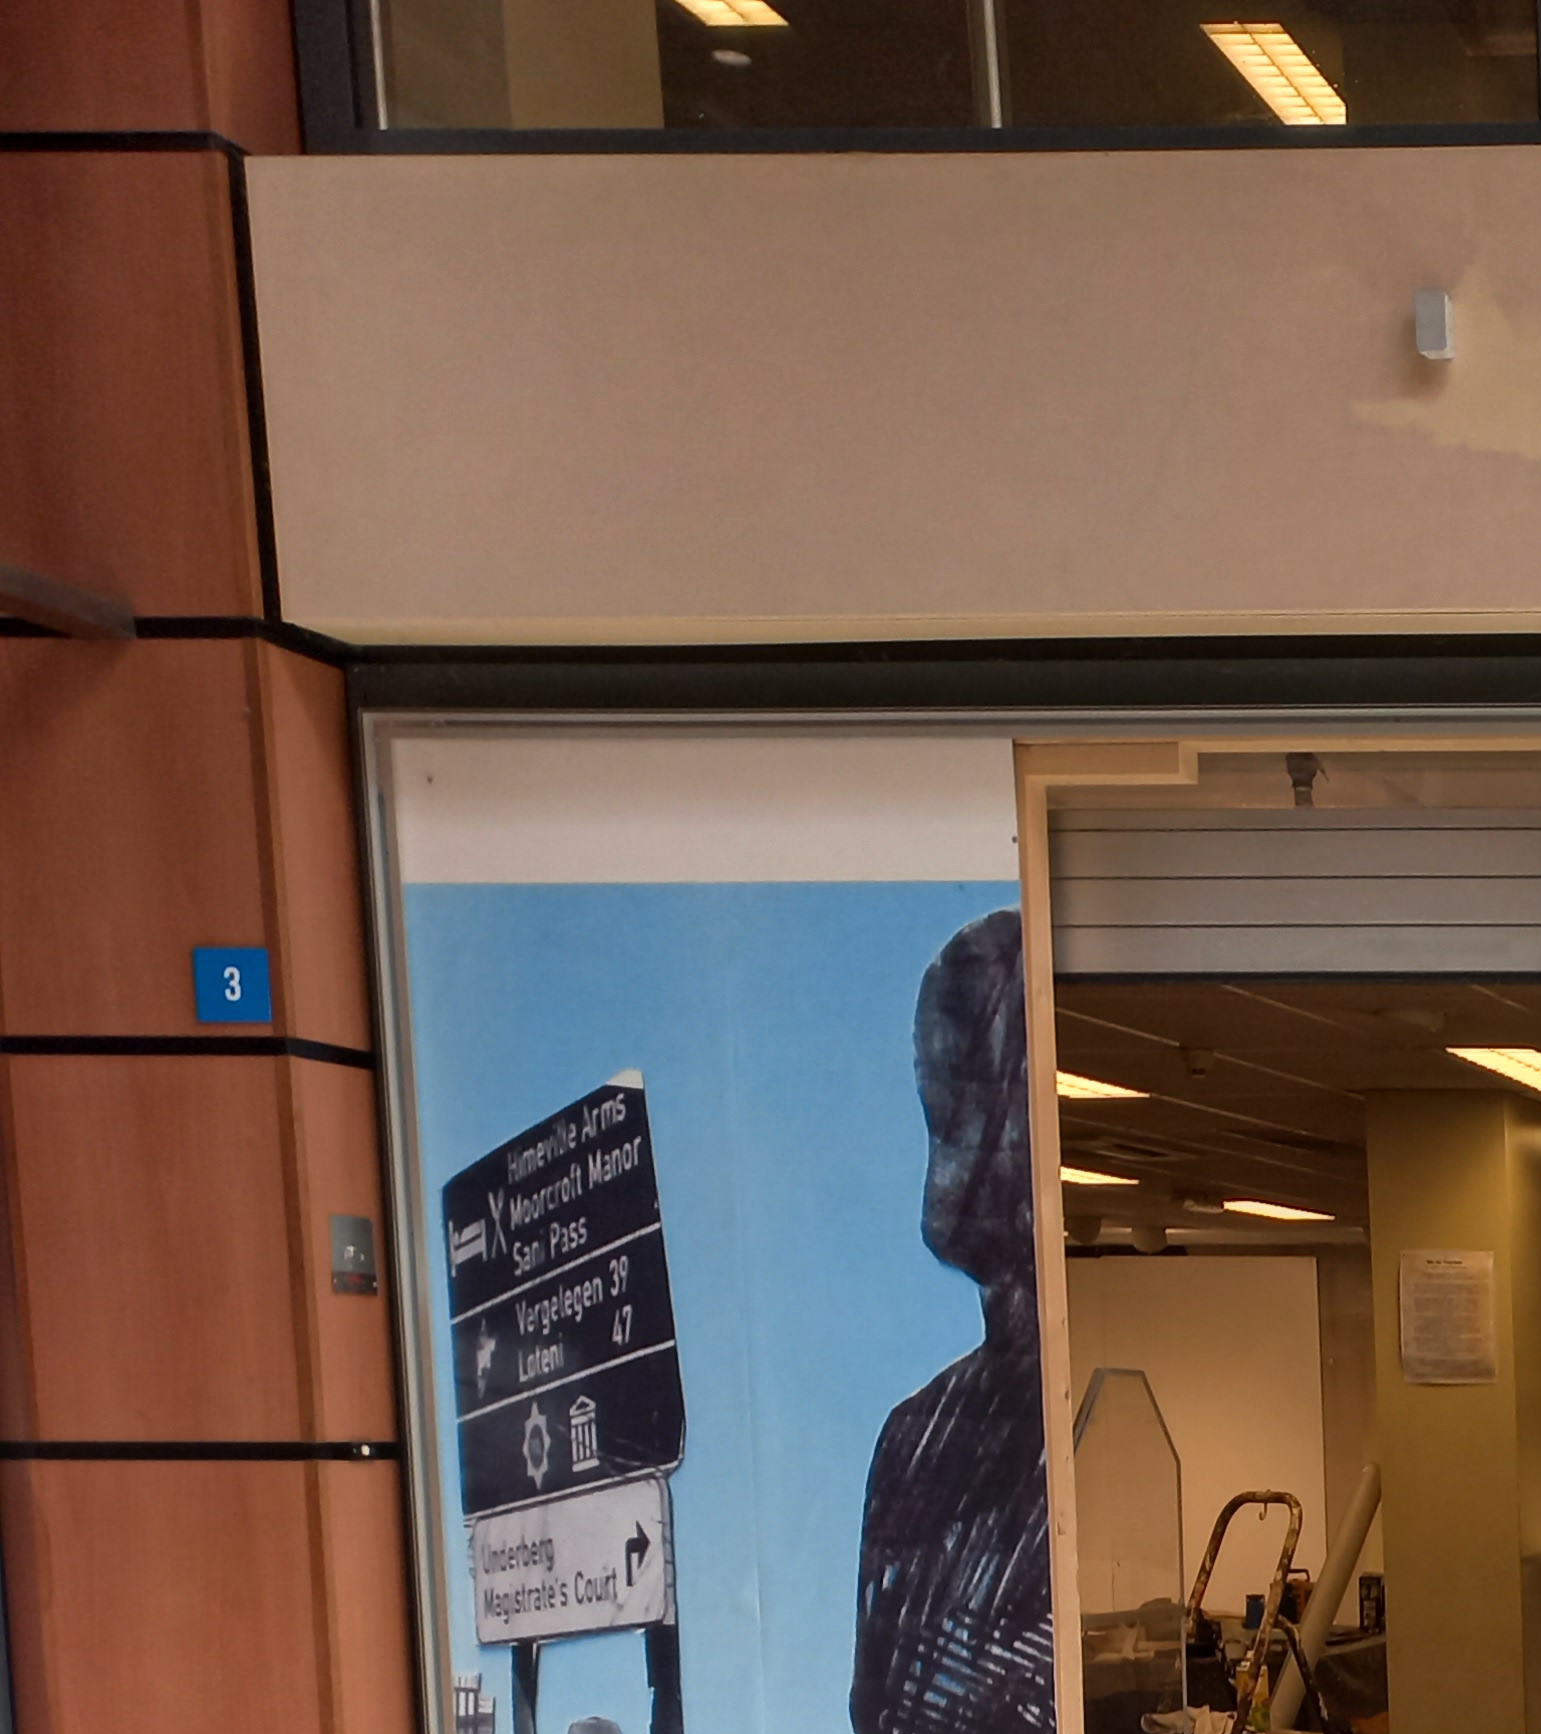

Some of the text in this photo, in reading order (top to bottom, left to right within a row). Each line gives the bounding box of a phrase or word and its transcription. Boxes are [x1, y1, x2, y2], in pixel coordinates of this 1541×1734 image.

[223, 966, 241, 1001] 3
[582, 1092, 627, 1144] Arms
[509, 1136, 642, 1230] Moorcroft Manor
[550, 1216, 588, 1259] Pass
[515, 1255, 629, 1336] Vergelegen 39
[611, 1304, 633, 1346] 47
[483, 1568, 618, 1625] Magistrate's Court
